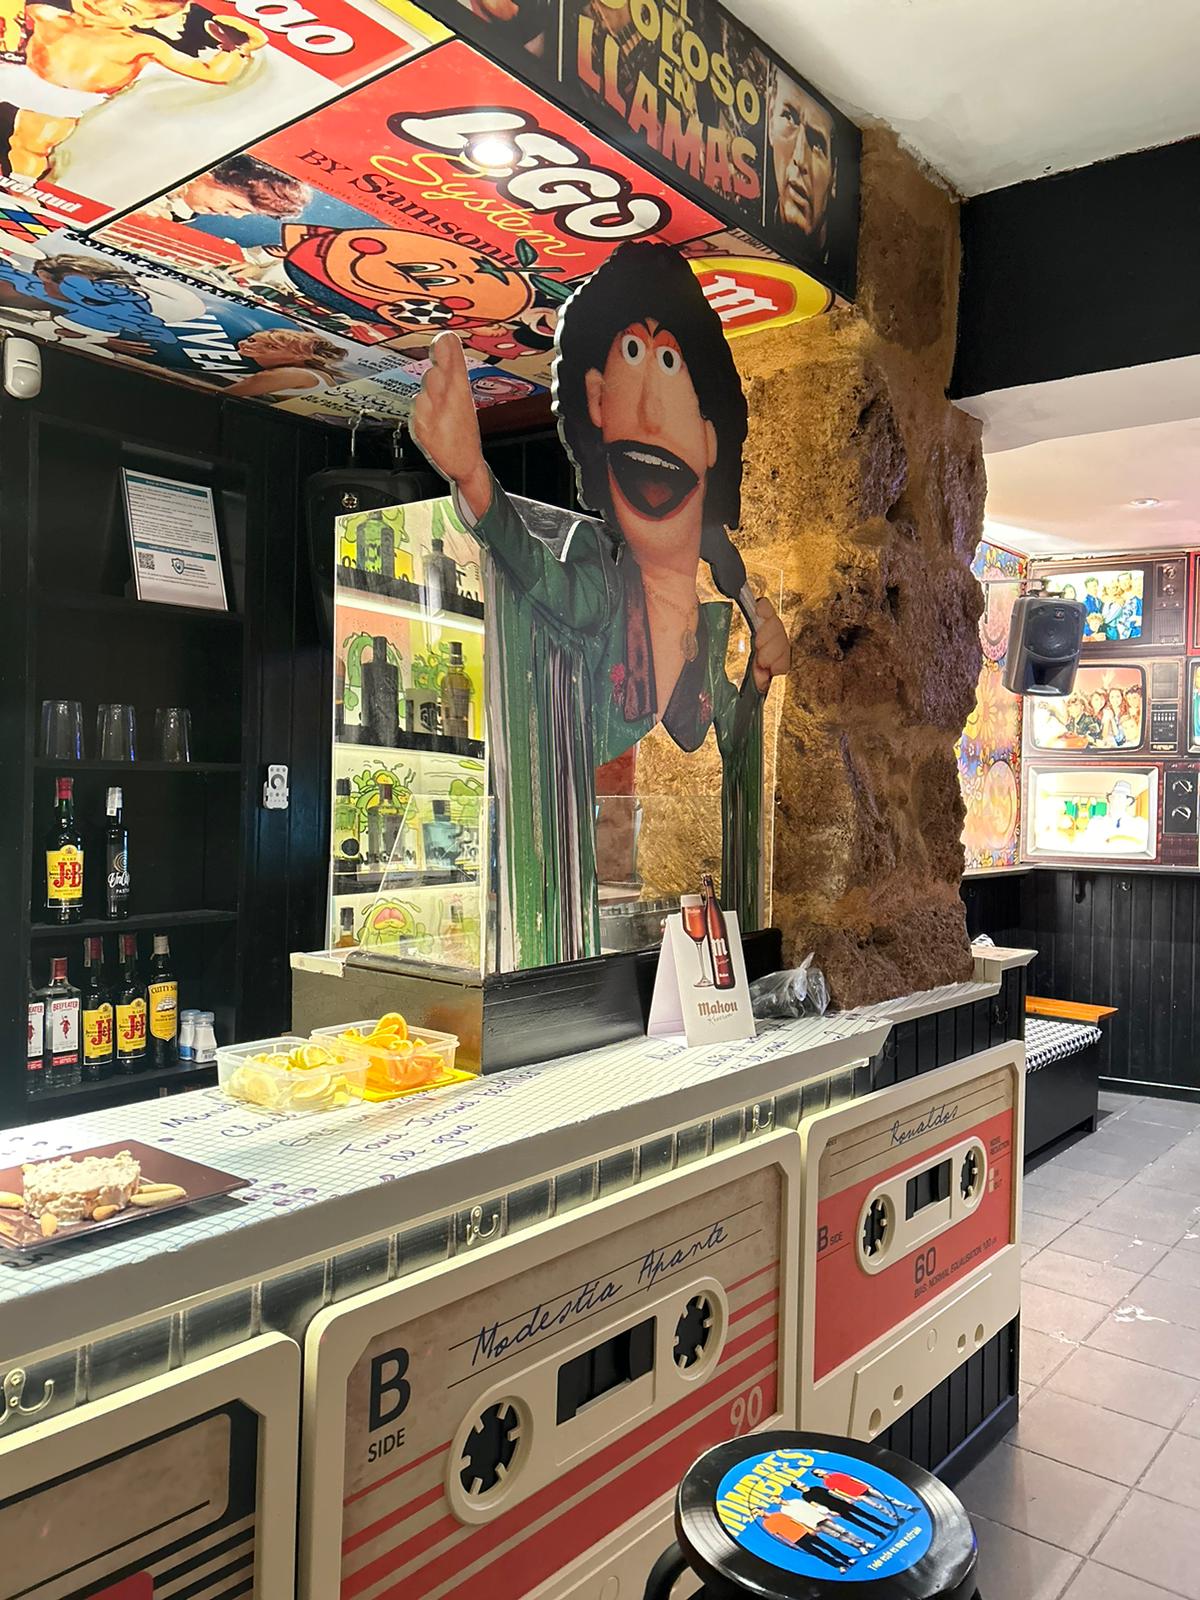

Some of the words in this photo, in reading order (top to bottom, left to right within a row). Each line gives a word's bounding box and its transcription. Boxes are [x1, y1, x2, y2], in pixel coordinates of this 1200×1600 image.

[596, 0, 760, 125] OLOSO
[658, 56, 698, 112] EN
[577, 14, 761, 200] LLAMAS
[296, 148, 352, 176] BY
[388, 107, 670, 242] LEGO
[369, 152, 585, 257] System
[163, 313, 250, 371] IVEA
[53, 861, 82, 888] J&B
[697, 1000, 738, 1016] Mahou
[338, 1130, 409, 1156] Toma
[817, 1225, 829, 1253] B
[830, 1231, 844, 1246] SIDE
[914, 1246, 936, 1285] 60
[472, 1280, 624, 1367] Modestia
[368, 1346, 412, 1434] B
[729, 1384, 763, 1437] 90
[367, 1428, 406, 1463] SIDE
